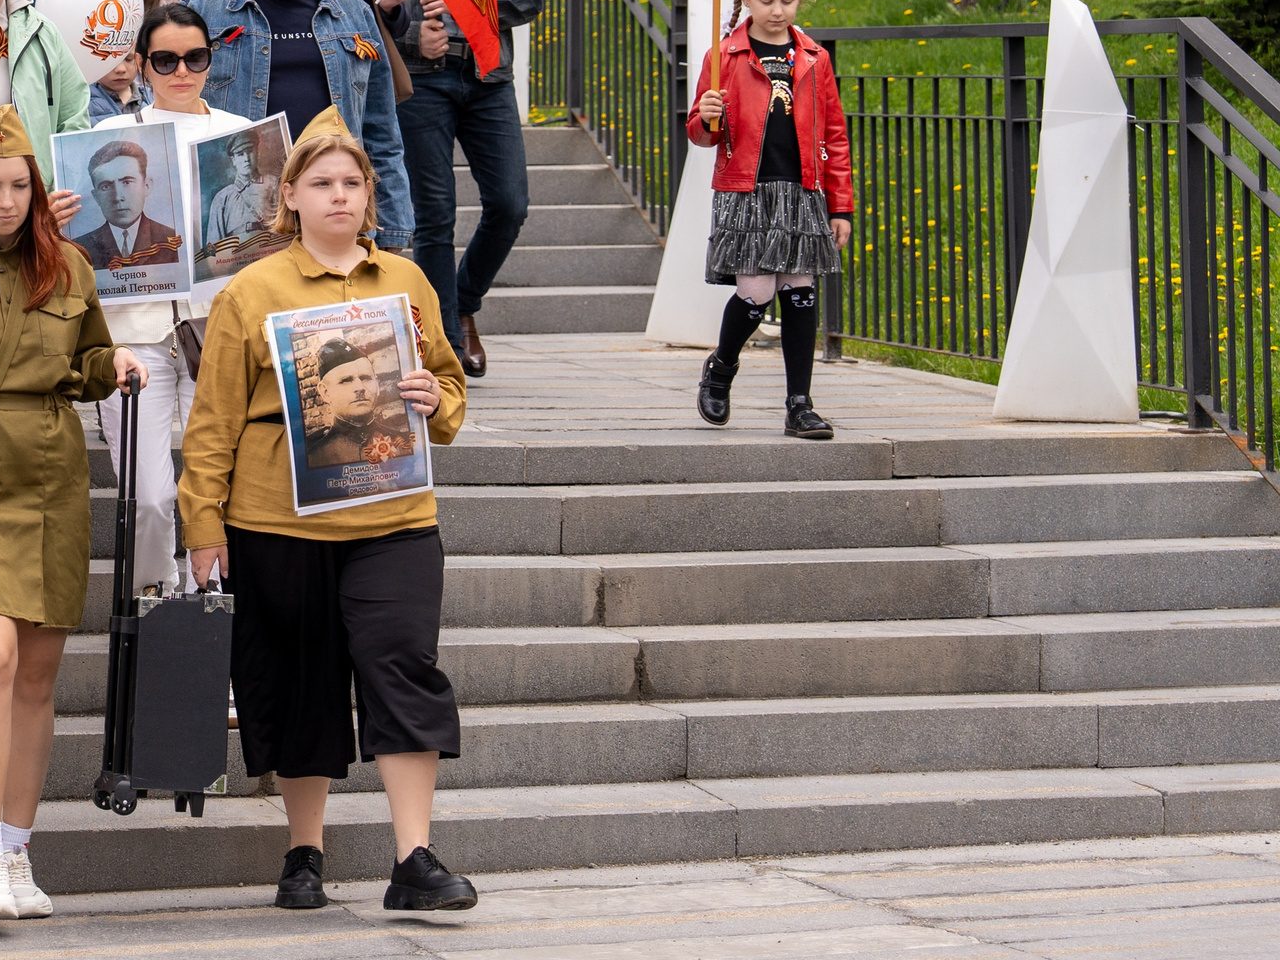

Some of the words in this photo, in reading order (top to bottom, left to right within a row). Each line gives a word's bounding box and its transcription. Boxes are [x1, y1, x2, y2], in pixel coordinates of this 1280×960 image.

[96, 0, 125, 40] 9
[281, 32, 313, 40] UNSTO
[111, 271, 147, 282] Чернов
[97, 284, 127, 296] иколай
[129, 282, 177, 293] Петрович
[291, 312, 348, 329] бессмертный
[364, 310, 388, 320] ПОЛК
[342, 465, 380, 476] Демидов
[327, 478, 348, 488] Петр
[348, 472, 399, 486] Михайлович
